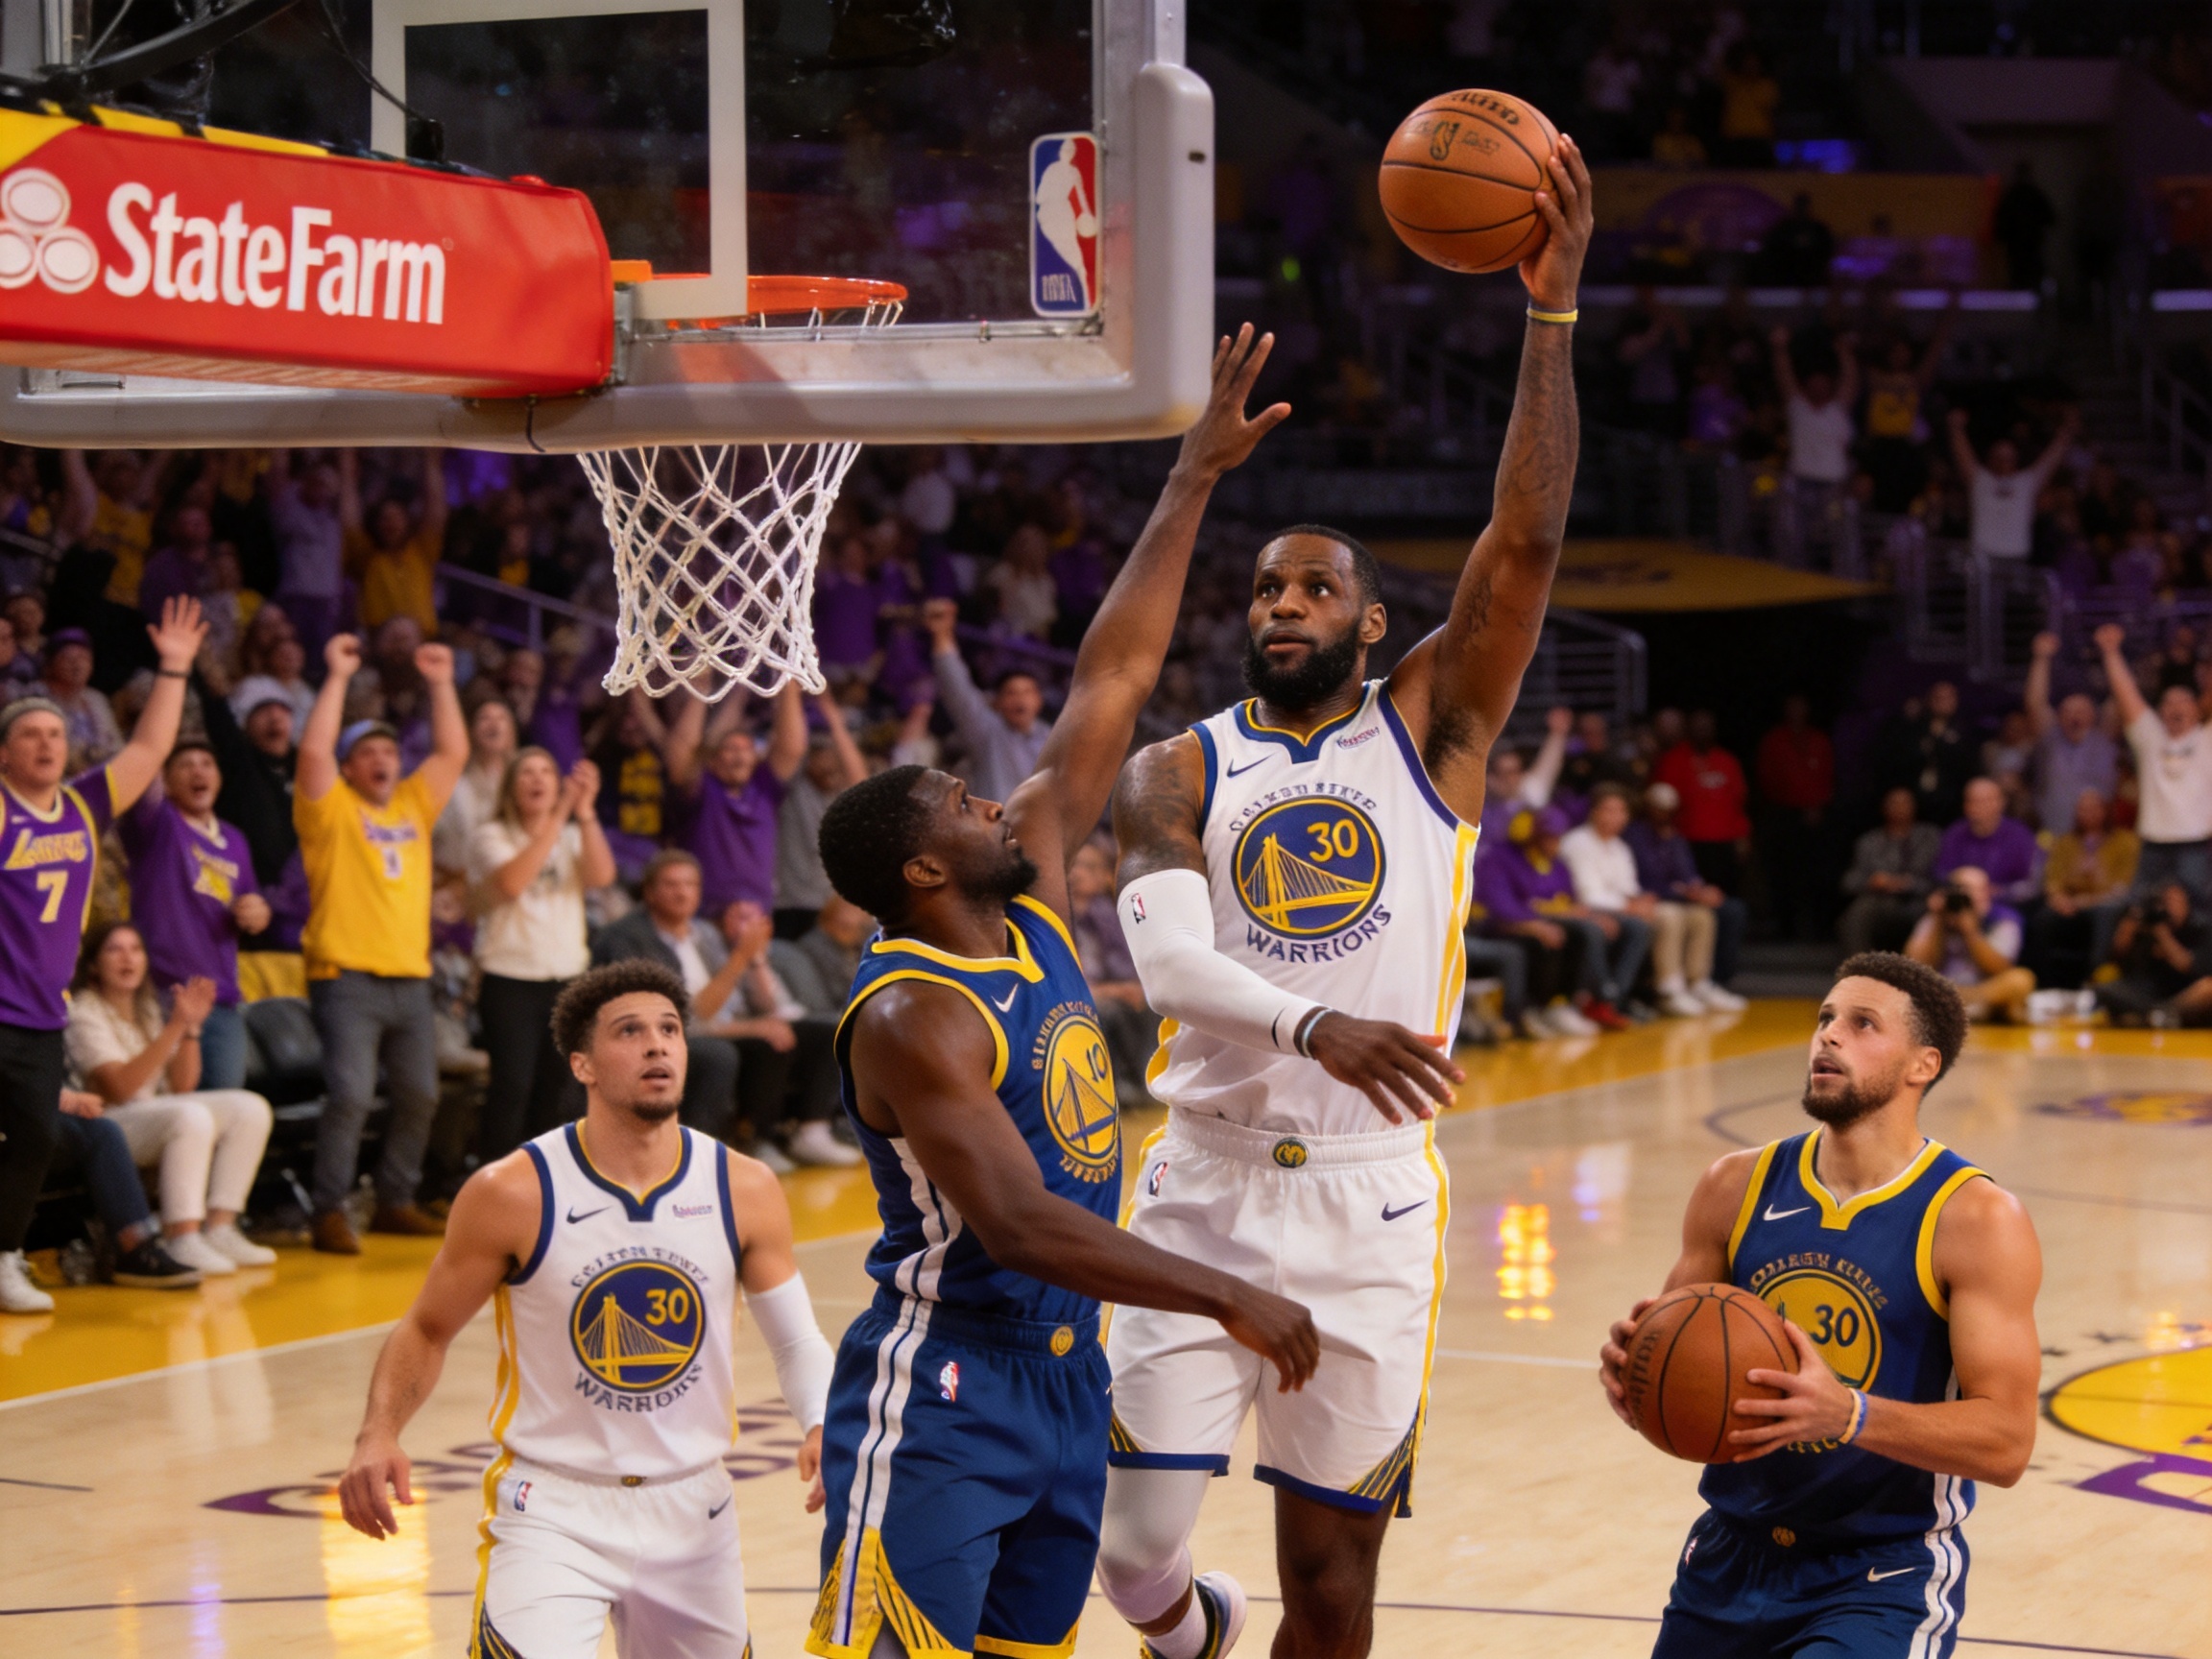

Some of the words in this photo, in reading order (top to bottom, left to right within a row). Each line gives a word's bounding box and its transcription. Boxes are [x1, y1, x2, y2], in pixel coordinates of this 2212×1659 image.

[1307, 818, 1359, 863] 30
[36, 870, 69, 924] 7
[645, 1287, 689, 1327] 30
[1808, 1303, 1860, 1348] 30
